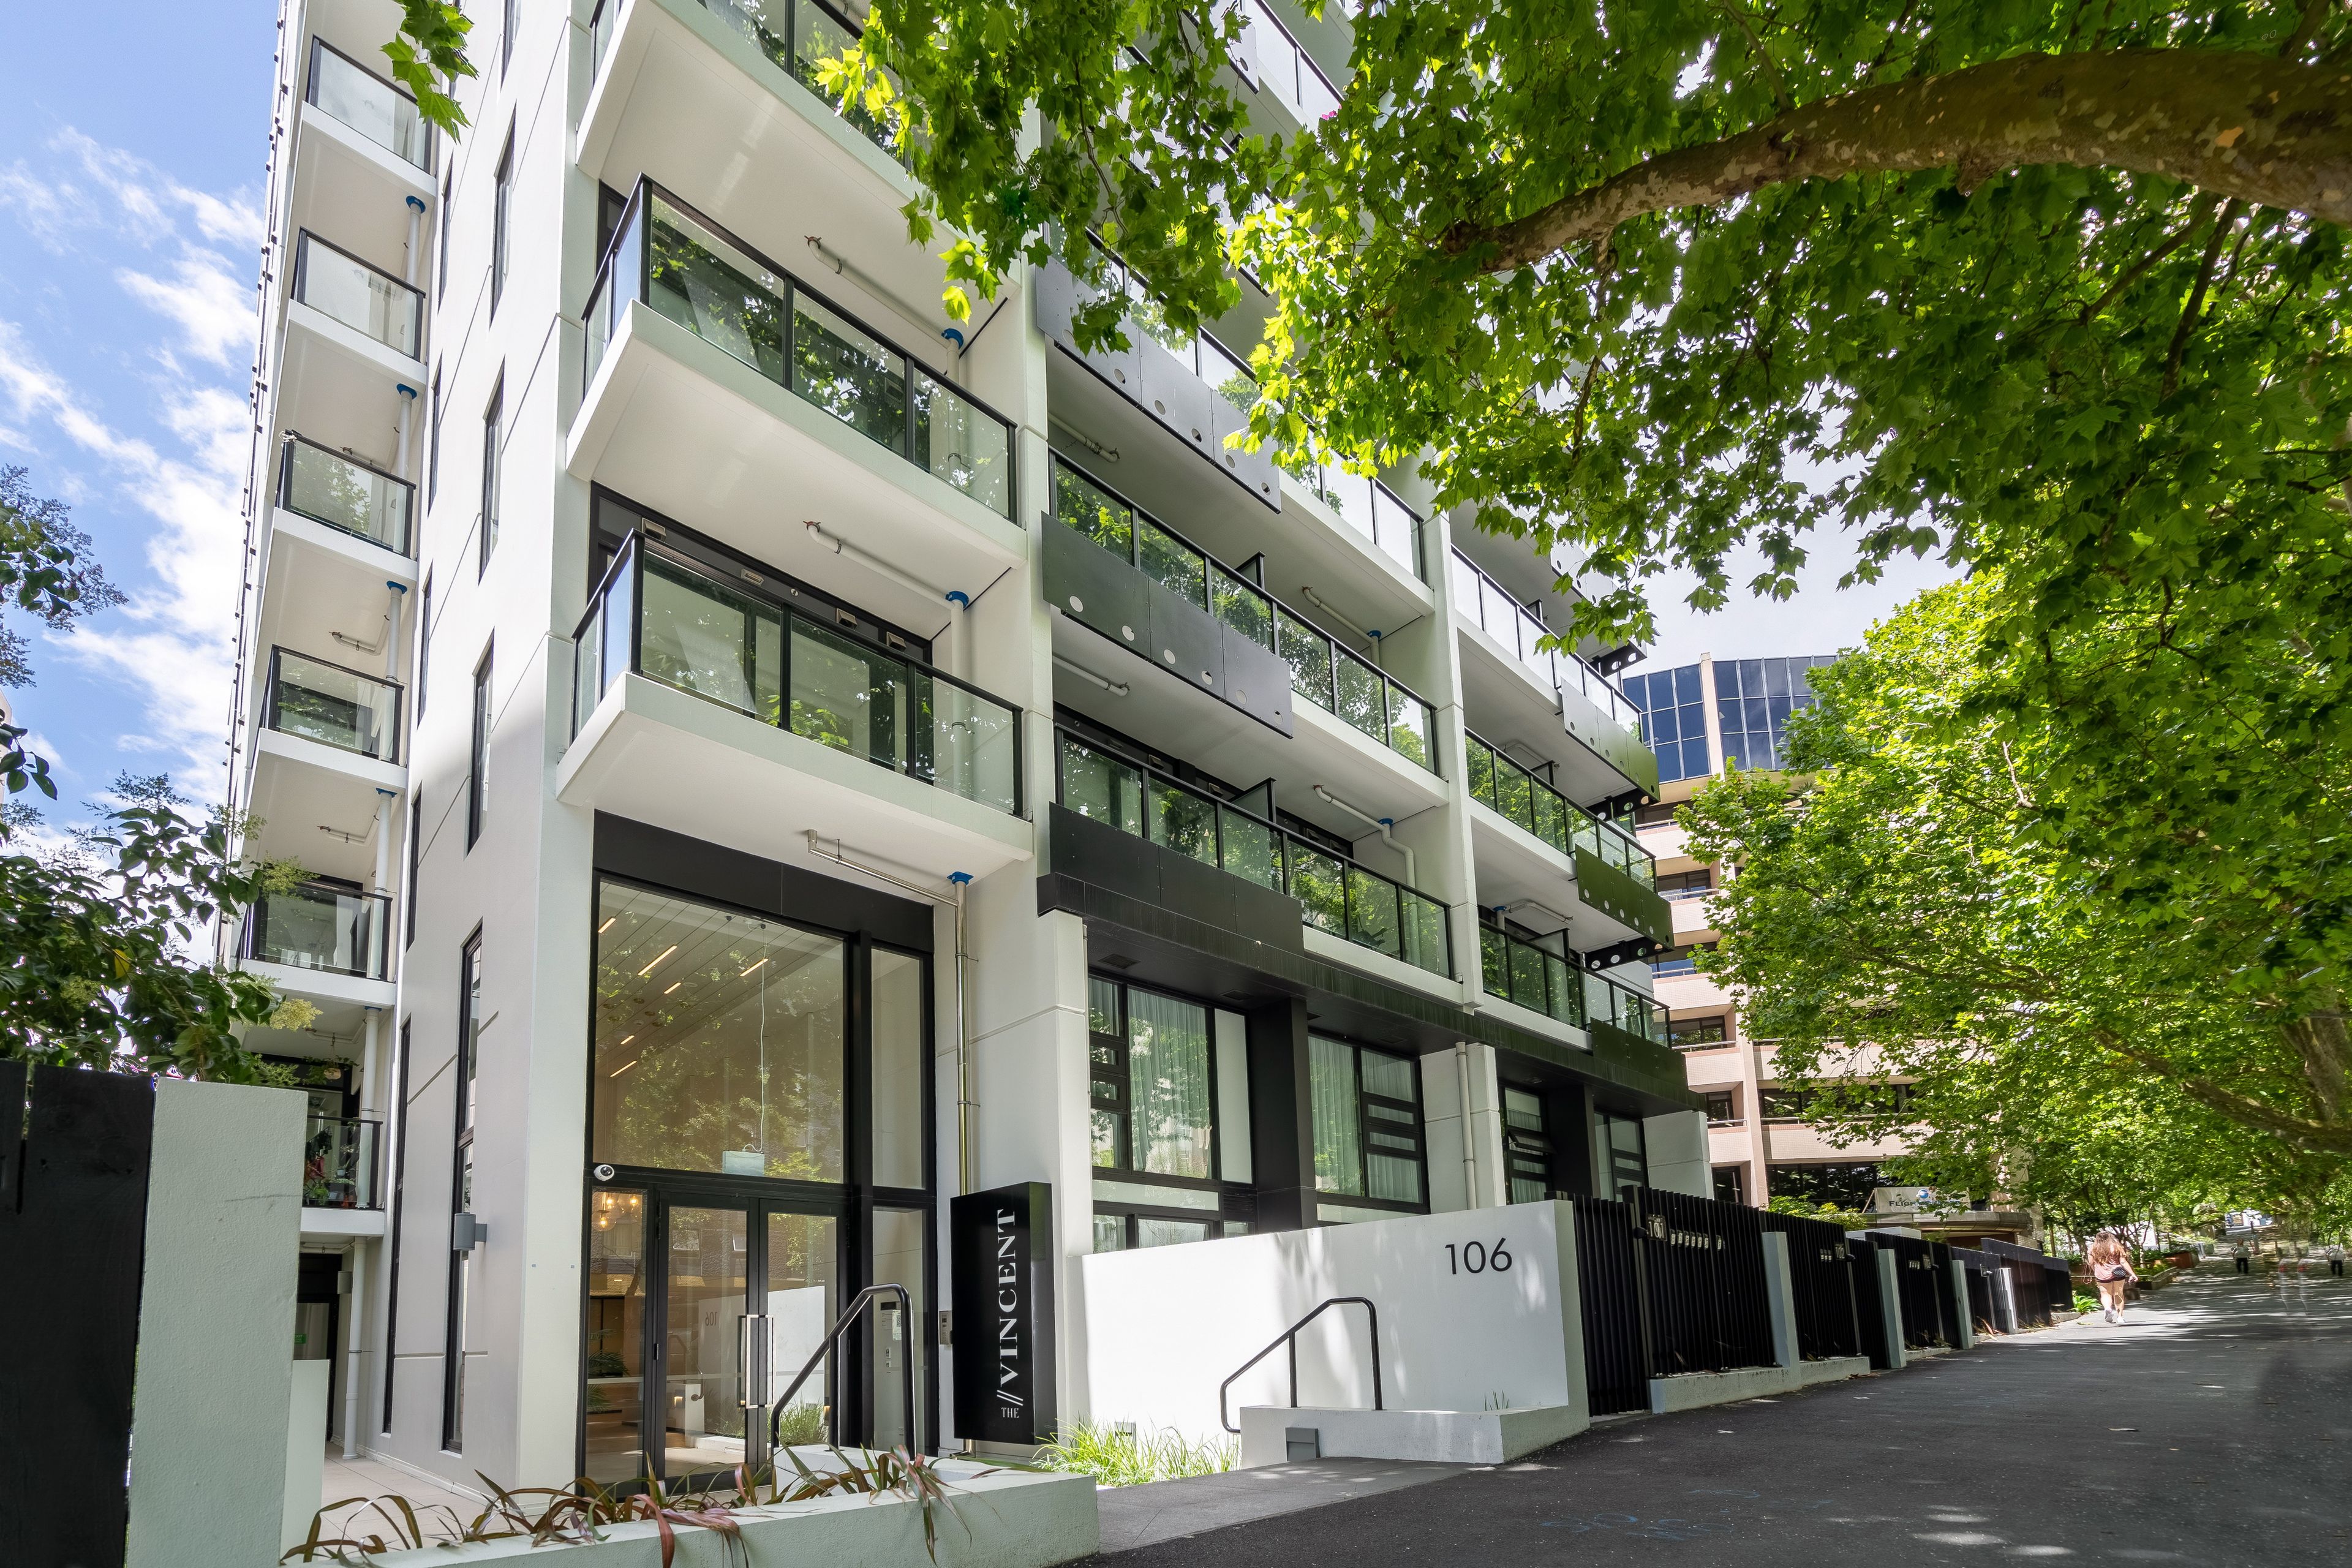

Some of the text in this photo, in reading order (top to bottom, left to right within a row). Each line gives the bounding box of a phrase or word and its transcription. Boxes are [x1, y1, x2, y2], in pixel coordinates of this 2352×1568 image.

[1648, 1221, 1664, 1238] 101
[1444, 1237, 1512, 1275] 106
[1001, 1407, 1019, 1418] THE
